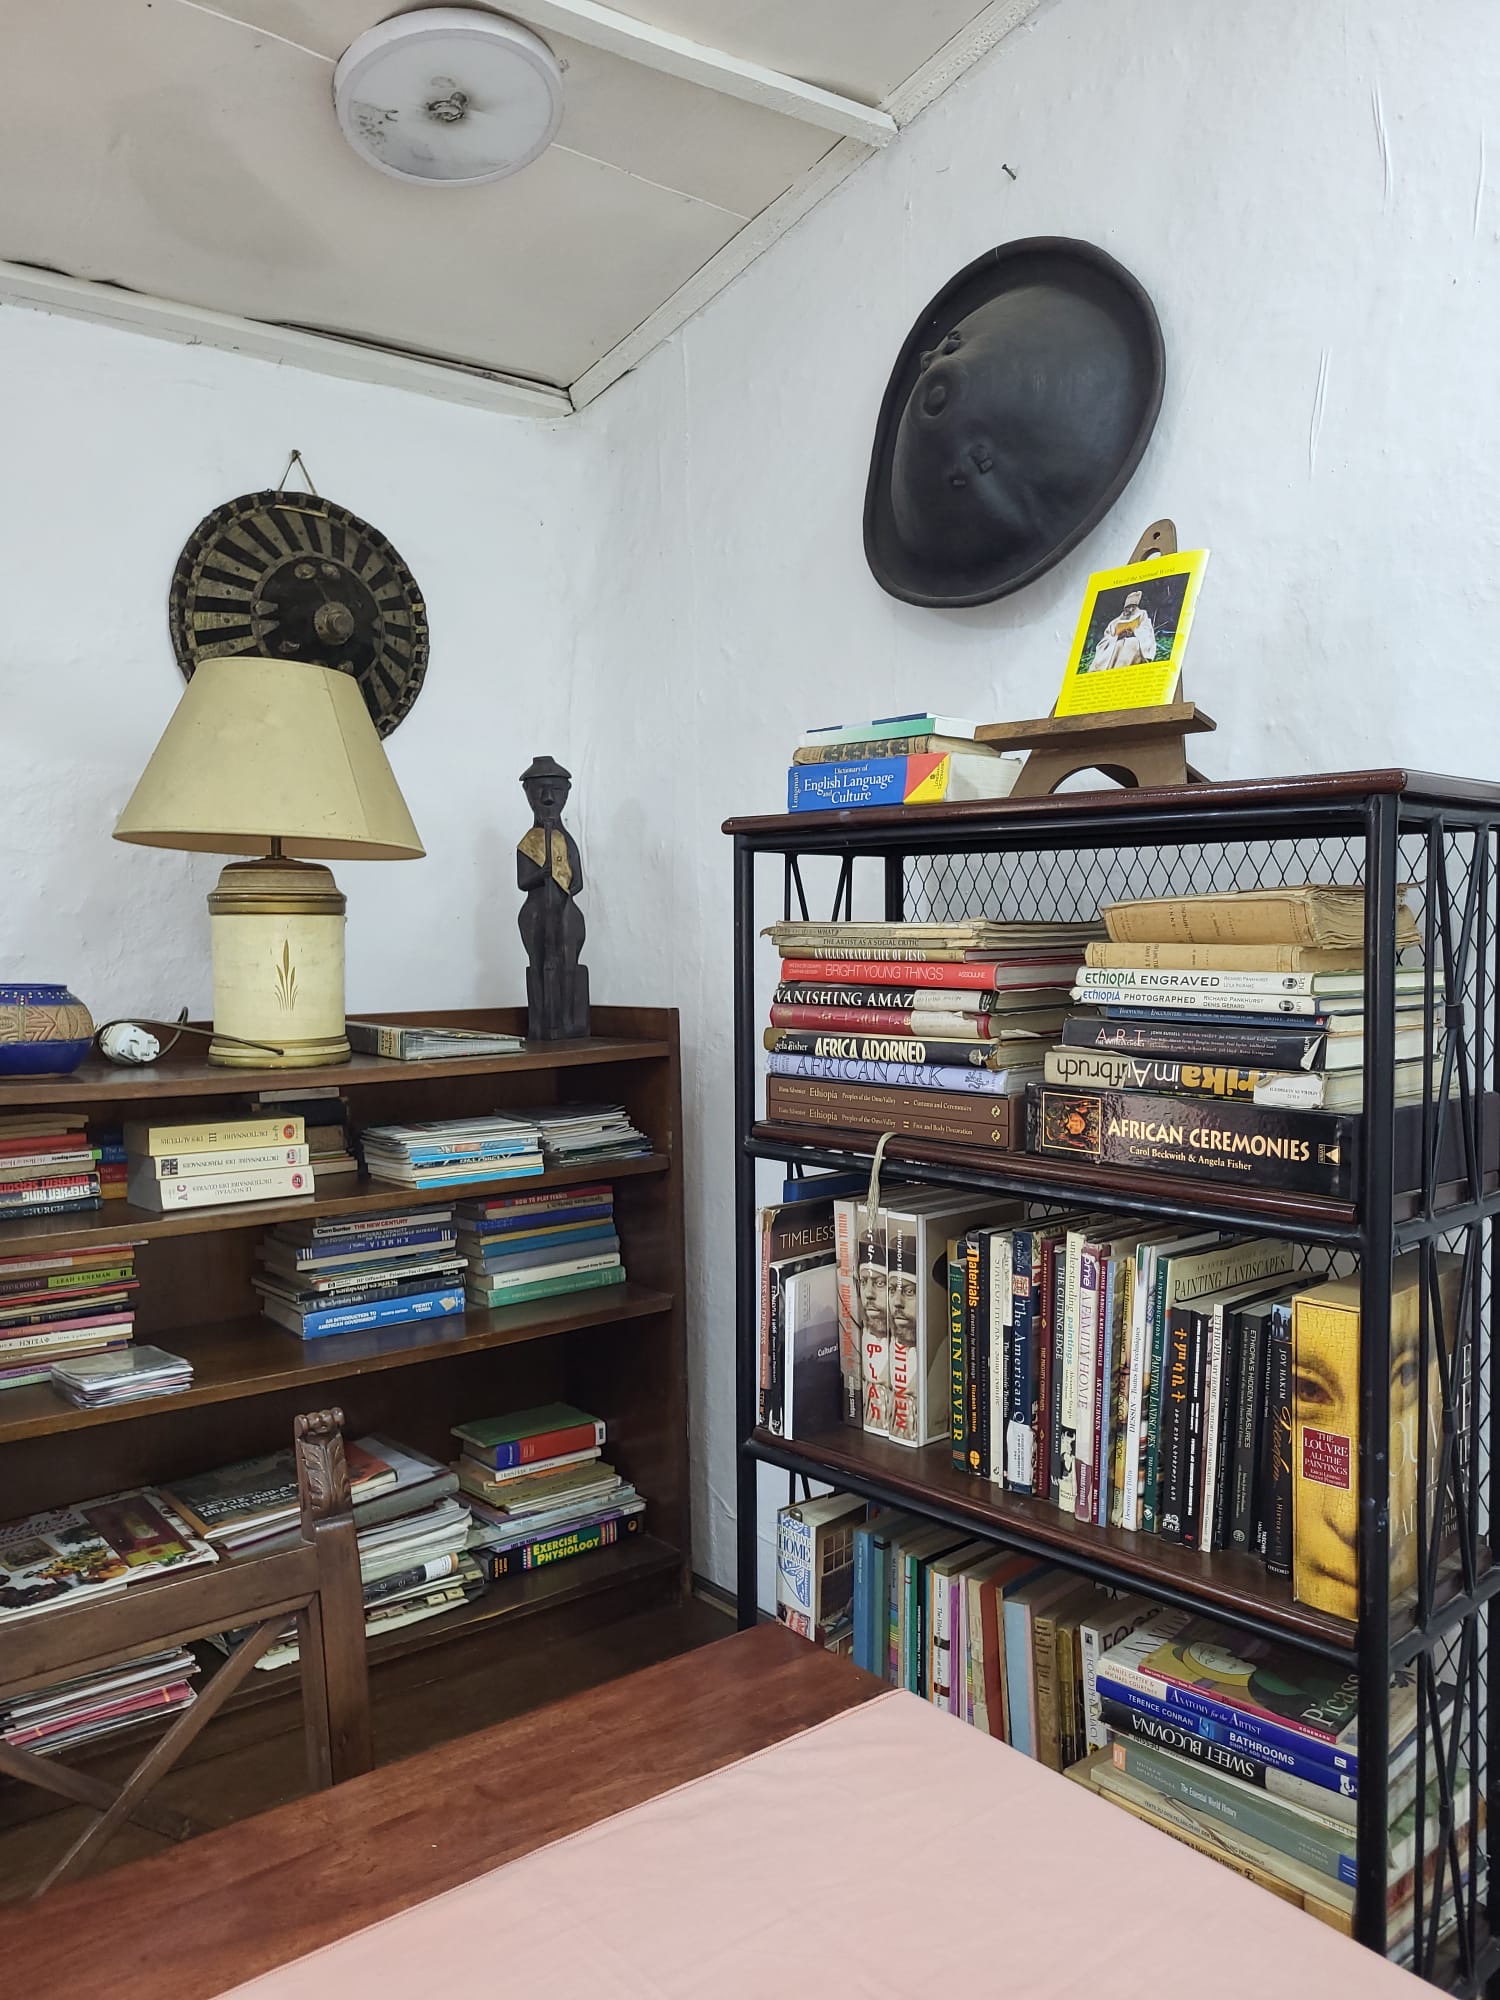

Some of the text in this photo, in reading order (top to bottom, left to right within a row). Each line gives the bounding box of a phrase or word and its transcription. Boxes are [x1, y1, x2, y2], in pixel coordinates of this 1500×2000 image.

[804, 772, 894, 796] English Language
[834, 764, 868, 776] Dictionary of
[792, 772, 800, 808] Longman
[822, 790, 872, 804] and Culture
[814, 948, 926, 961] AN ILLUSTRATED LIFE OF JESUS
[836, 938, 857, 946] ARTIST
[858, 938, 867, 946] AS
[868, 938, 874, 946] A
[876, 938, 896, 946] SOCIAL
[898, 938, 919, 947] CRITIC
[825, 963, 861, 977] BRIGHT
[864, 965, 900, 979] YOUNG
[904, 966, 944, 981] THINGS
[1140, 974, 1220, 987] ENGRAVED
[776, 988, 862, 1006] VANISHING
[1124, 993, 1196, 1004] PHOTOGRAPHED
[1229, 996, 1264, 1004] PANKHURST
[814, 1038, 859, 1060] AFRICA
[862, 1038, 926, 1064] ADORNED
[796, 1056, 890, 1083] AFRICAN
[895, 1061, 945, 1087] ARK
[1056, 1058, 1180, 1090] im Aufbruch
[809, 1088, 838, 1102] Ethiopia
[842, 1092, 858, 1100] Peoples
[809, 1108, 838, 1123] Ethiopia
[923, 1122, 933, 1130] and
[1107, 1118, 1311, 1163] AFRICAN CEREMONIES
[1129, 1146, 1252, 1172] Carol Beckwith & Angela Fisher
[22, 1185, 90, 1203] STEPHEN KING
[528, 1196, 536, 1204] TO
[366, 1222, 381, 1230] NEW
[381, 1218, 408, 1227] CENTURY
[780, 1224, 836, 1250] TIMELESS
[1174, 1254, 1288, 1298] PAINTING LANDSCAPES
[1056, 1265, 1066, 1360] THE CUTTING EDGE
[1066, 1240, 1076, 1365] understanding paintings
[1080, 1304, 1091, 1360] FAMILY
[1212, 1314, 1222, 1374] ETHIOPIA MY
[950, 1292, 964, 1442] CABIN FEVER
[1014, 1300, 1027, 1406] The American
[1148, 1270, 1164, 1448] AN INTRODUCTION TO PAINTING LANDSCAPES
[894, 1343, 907, 1430] MENELIK
[1078, 1362, 1090, 1409] HOME
[1128, 1402, 1137, 1433] DESSIN
[1133, 1327, 1142, 1362] techniques
[1244, 1329, 1257, 1448] ETHIOPIA'S HIDDEN TREASURES
[1278, 1348, 1287, 1400] JOY HAKIM
[1272, 1404, 1293, 1482] Freedom
[1304, 1437, 1348, 1458] LOUVRE
[1317, 1432, 1334, 1442] THE
[1304, 1457, 1348, 1476] PAINTINGS
[1310, 1451, 1342, 1466] ALL THE
[533, 1534, 578, 1556] EXERCISE
[536, 1537, 600, 1566] PHYSIOLOGY
[778, 1533, 811, 1564] HOME
[1086, 1658, 1097, 1687] FOOD
[1128, 1693, 1194, 1726] TERENCE CONRAN
[1170, 1690, 1262, 1735] ANATOMY for the ARTIST
[1132, 1714, 1202, 1756] BUCOVINA
[1229, 1732, 1295, 1766] BATHROOMS
[1205, 1746, 1255, 1778] SWEET
[1180, 1782, 1189, 1793] The
